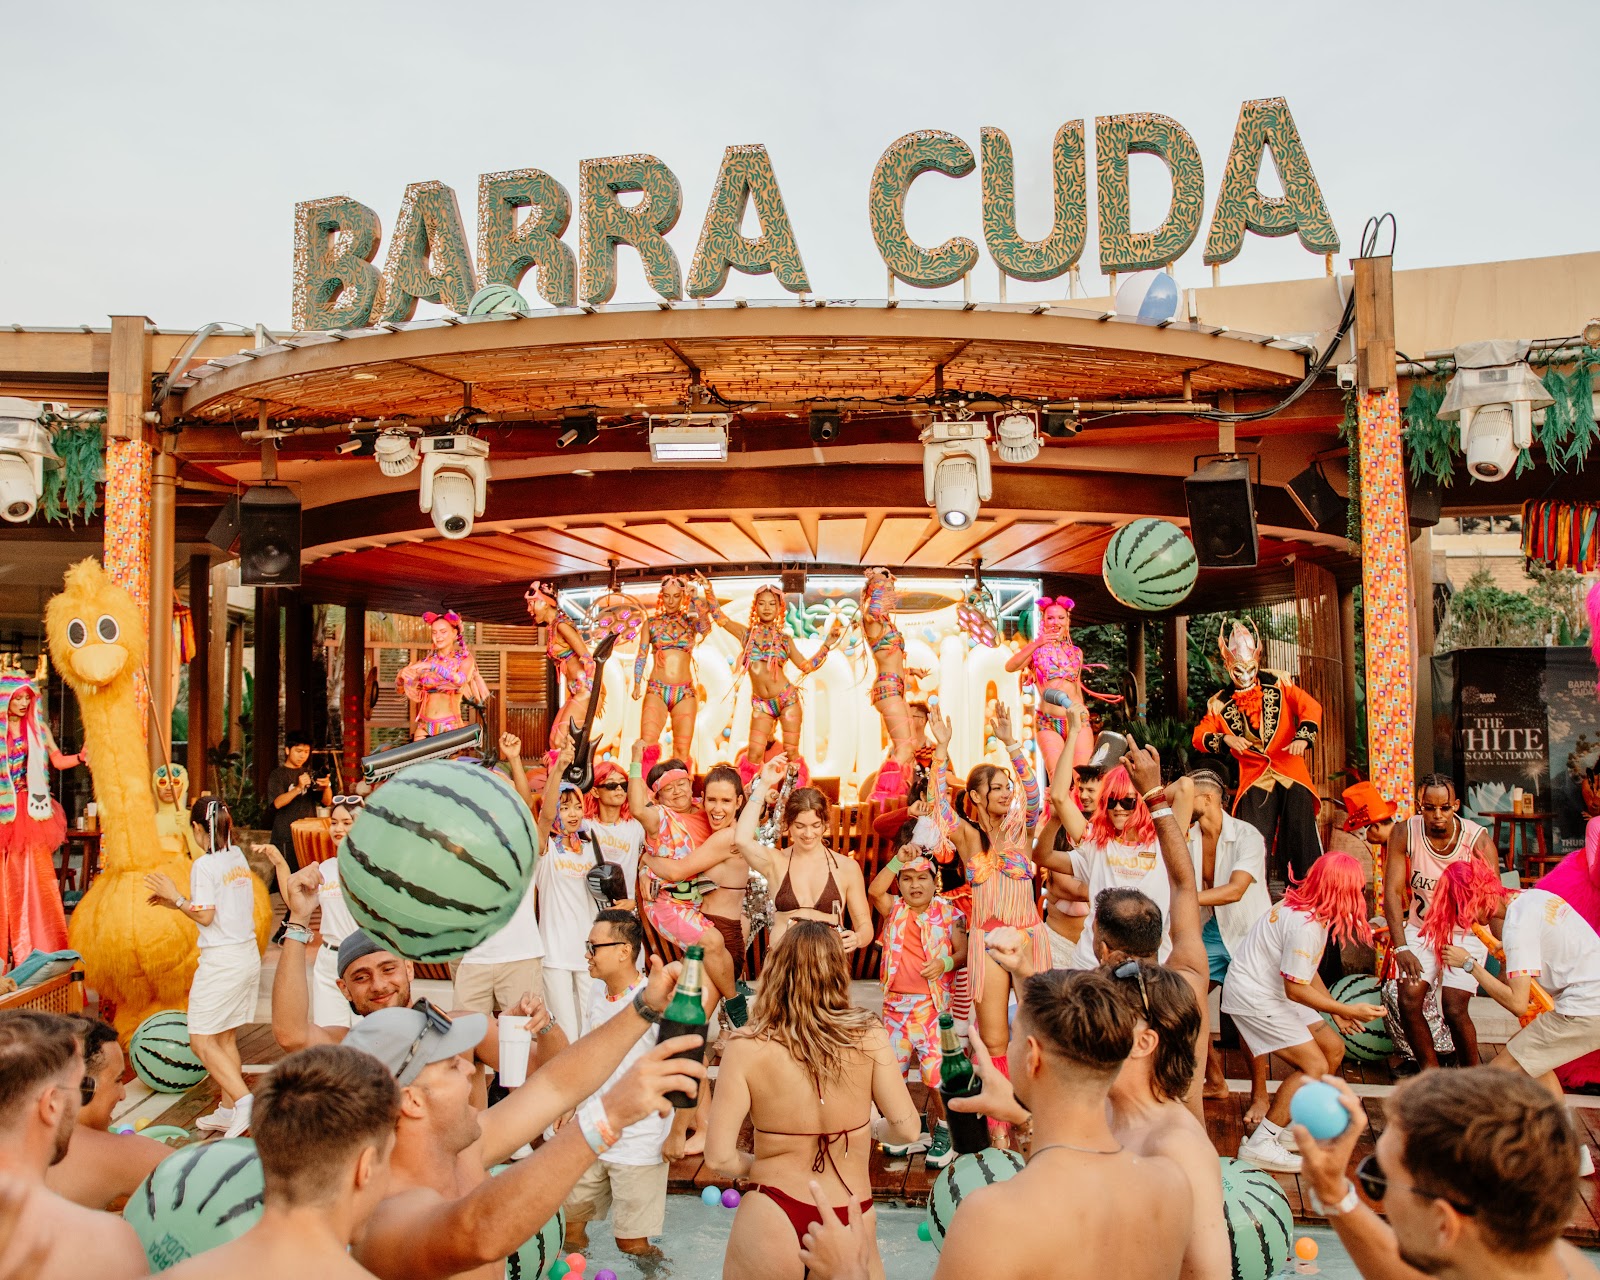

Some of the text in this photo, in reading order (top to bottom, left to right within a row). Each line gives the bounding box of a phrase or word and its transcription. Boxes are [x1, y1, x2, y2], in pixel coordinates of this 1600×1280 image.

[292, 96, 1340, 332] BARRA CUDA
[1474, 718, 1504, 728] THE
[1461, 729, 1543, 751] HITE
[1473, 752, 1543, 760] COUNTDOWN
[1561, 839, 1585, 847] THUR
